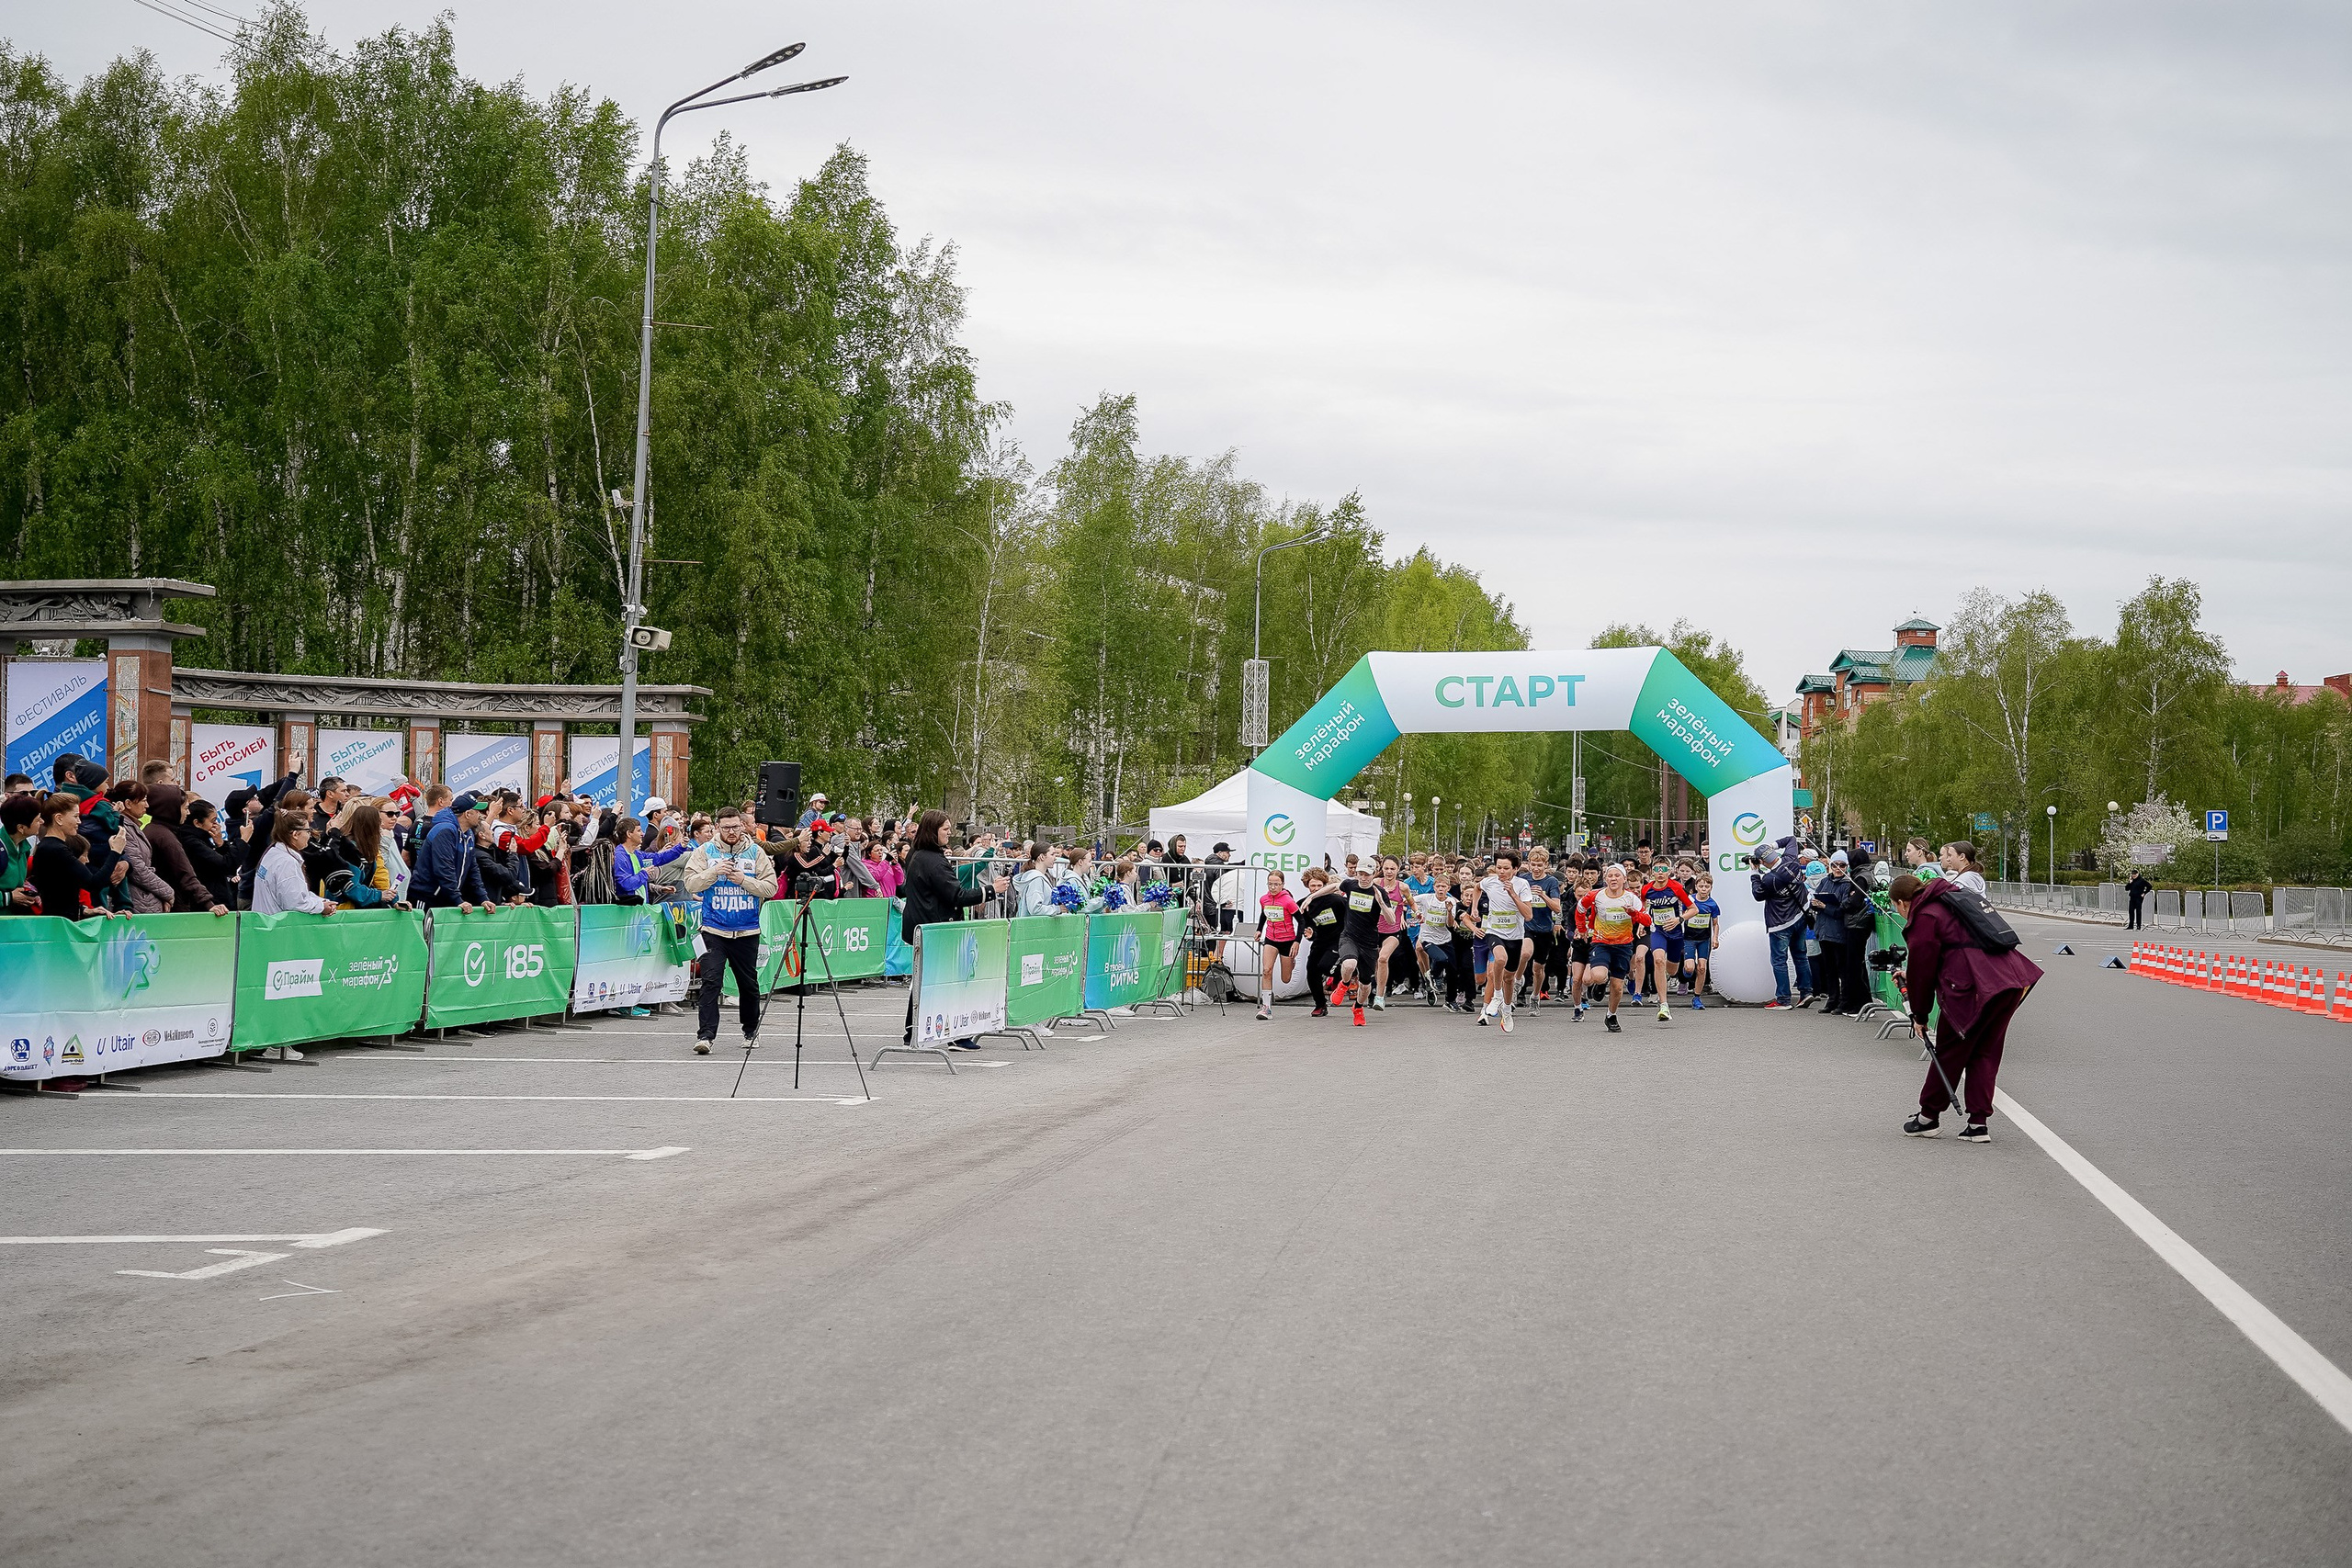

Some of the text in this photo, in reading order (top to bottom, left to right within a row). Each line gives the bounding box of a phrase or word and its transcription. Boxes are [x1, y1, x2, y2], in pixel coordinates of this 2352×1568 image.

[15, 675, 87, 726] ФЕСТИВАЛЬ
[1435, 675, 1586, 707] СТАРТ
[19, 709, 101, 774] ДВИЖЕНИЕ
[1295, 699, 1355, 760] зелёный
[1305, 713, 1366, 772] марафон
[1656, 709, 1721, 768] марафон
[1668, 698, 1735, 757] зелёный
[196, 737, 268, 782] С РОССИЕЙ
[199, 739, 236, 763] БЫТЬ
[330, 740, 367, 762] БЫТЬ
[335, 738, 395, 776] ДВИЖЕНИИ
[451, 743, 522, 784] БЫТЬ ВМЕСТЕ
[576, 750, 619, 779] ФЕСТИВА
[1250, 852, 1310, 872] СБЕР
[711, 896, 754, 912] СУДЬЯ
[843, 927, 869, 952] 185
[348, 956, 383, 972] зелёный
[503, 943, 544, 978] 185
[283, 969, 314, 988] Прайм
[342, 972, 379, 989] марафон
[111, 1033, 136, 1053] Utair
